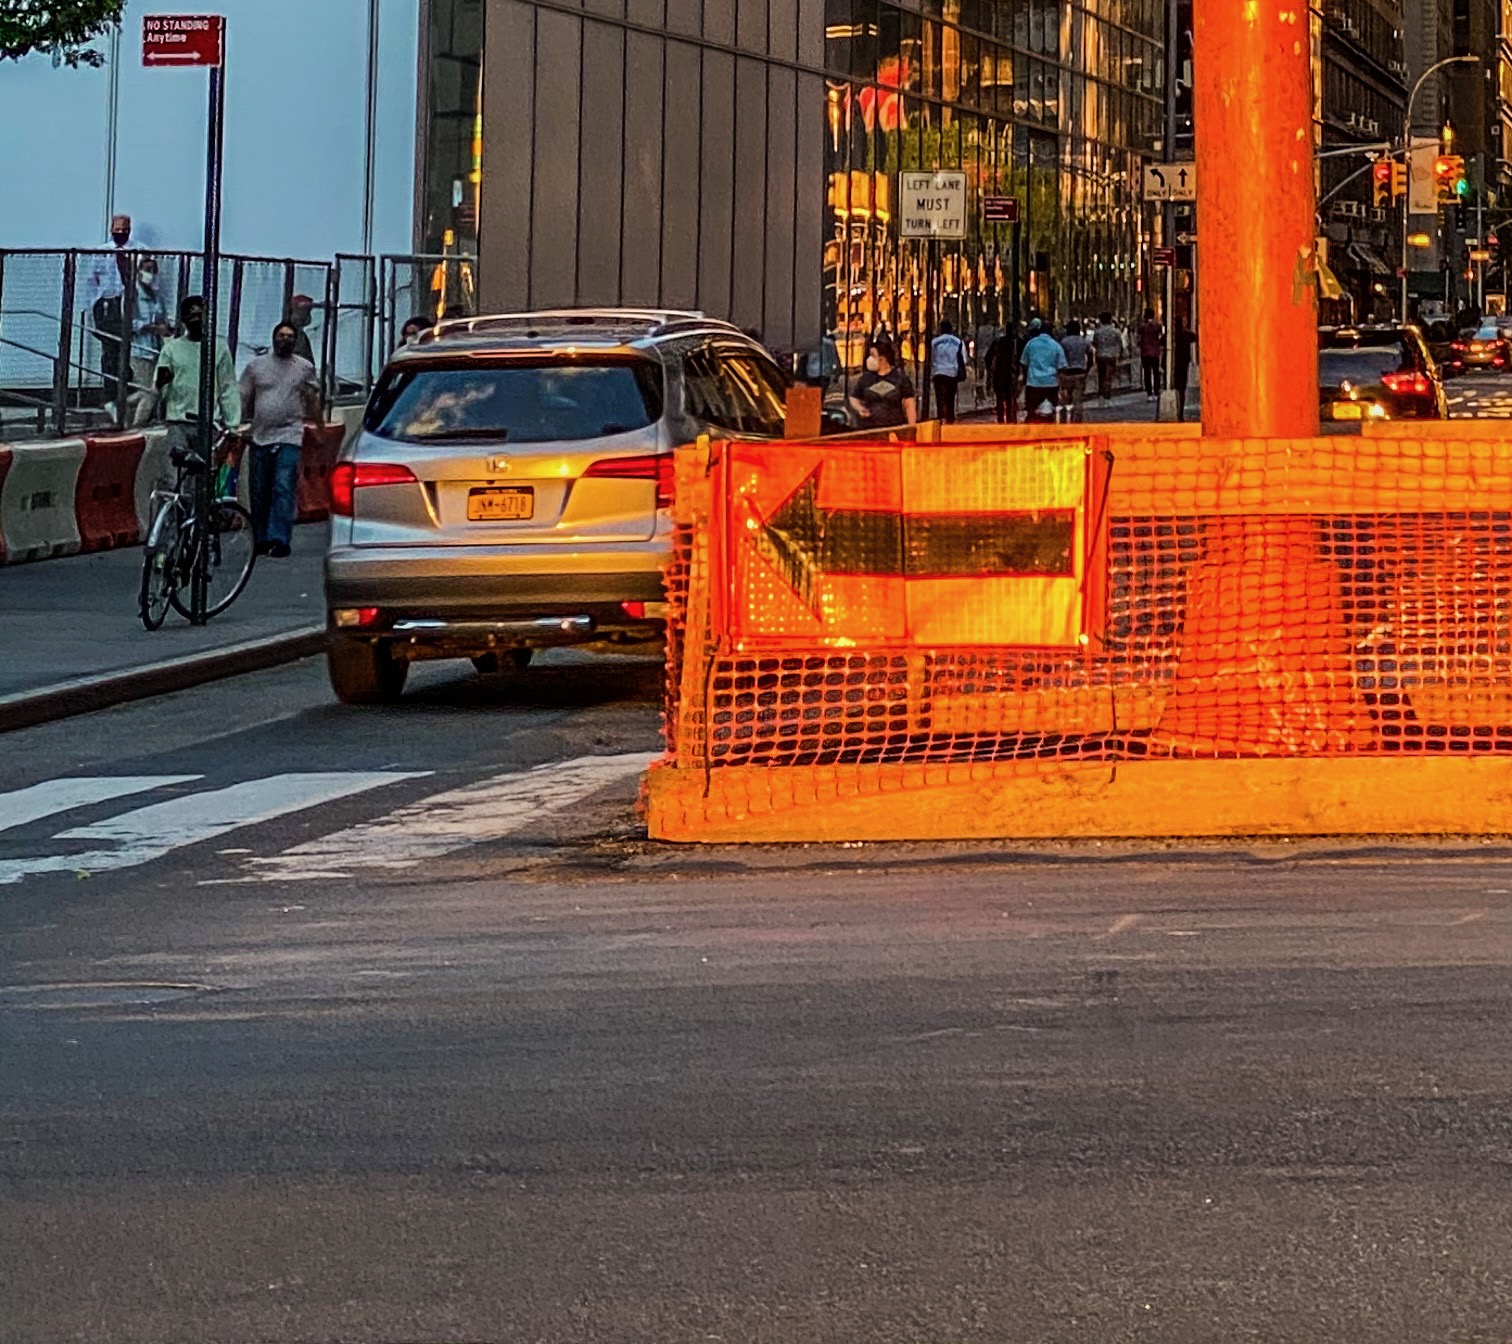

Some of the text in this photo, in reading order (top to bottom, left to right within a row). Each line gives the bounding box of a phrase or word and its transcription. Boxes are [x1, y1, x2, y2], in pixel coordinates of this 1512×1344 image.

[146, 20, 210, 31] NO STANDING
[146, 32, 188, 45] Anytime
[907, 180, 961, 191] LEFT LANE
[916, 198, 951, 212] MUST
[906, 219, 961, 230] TURN LEFT
